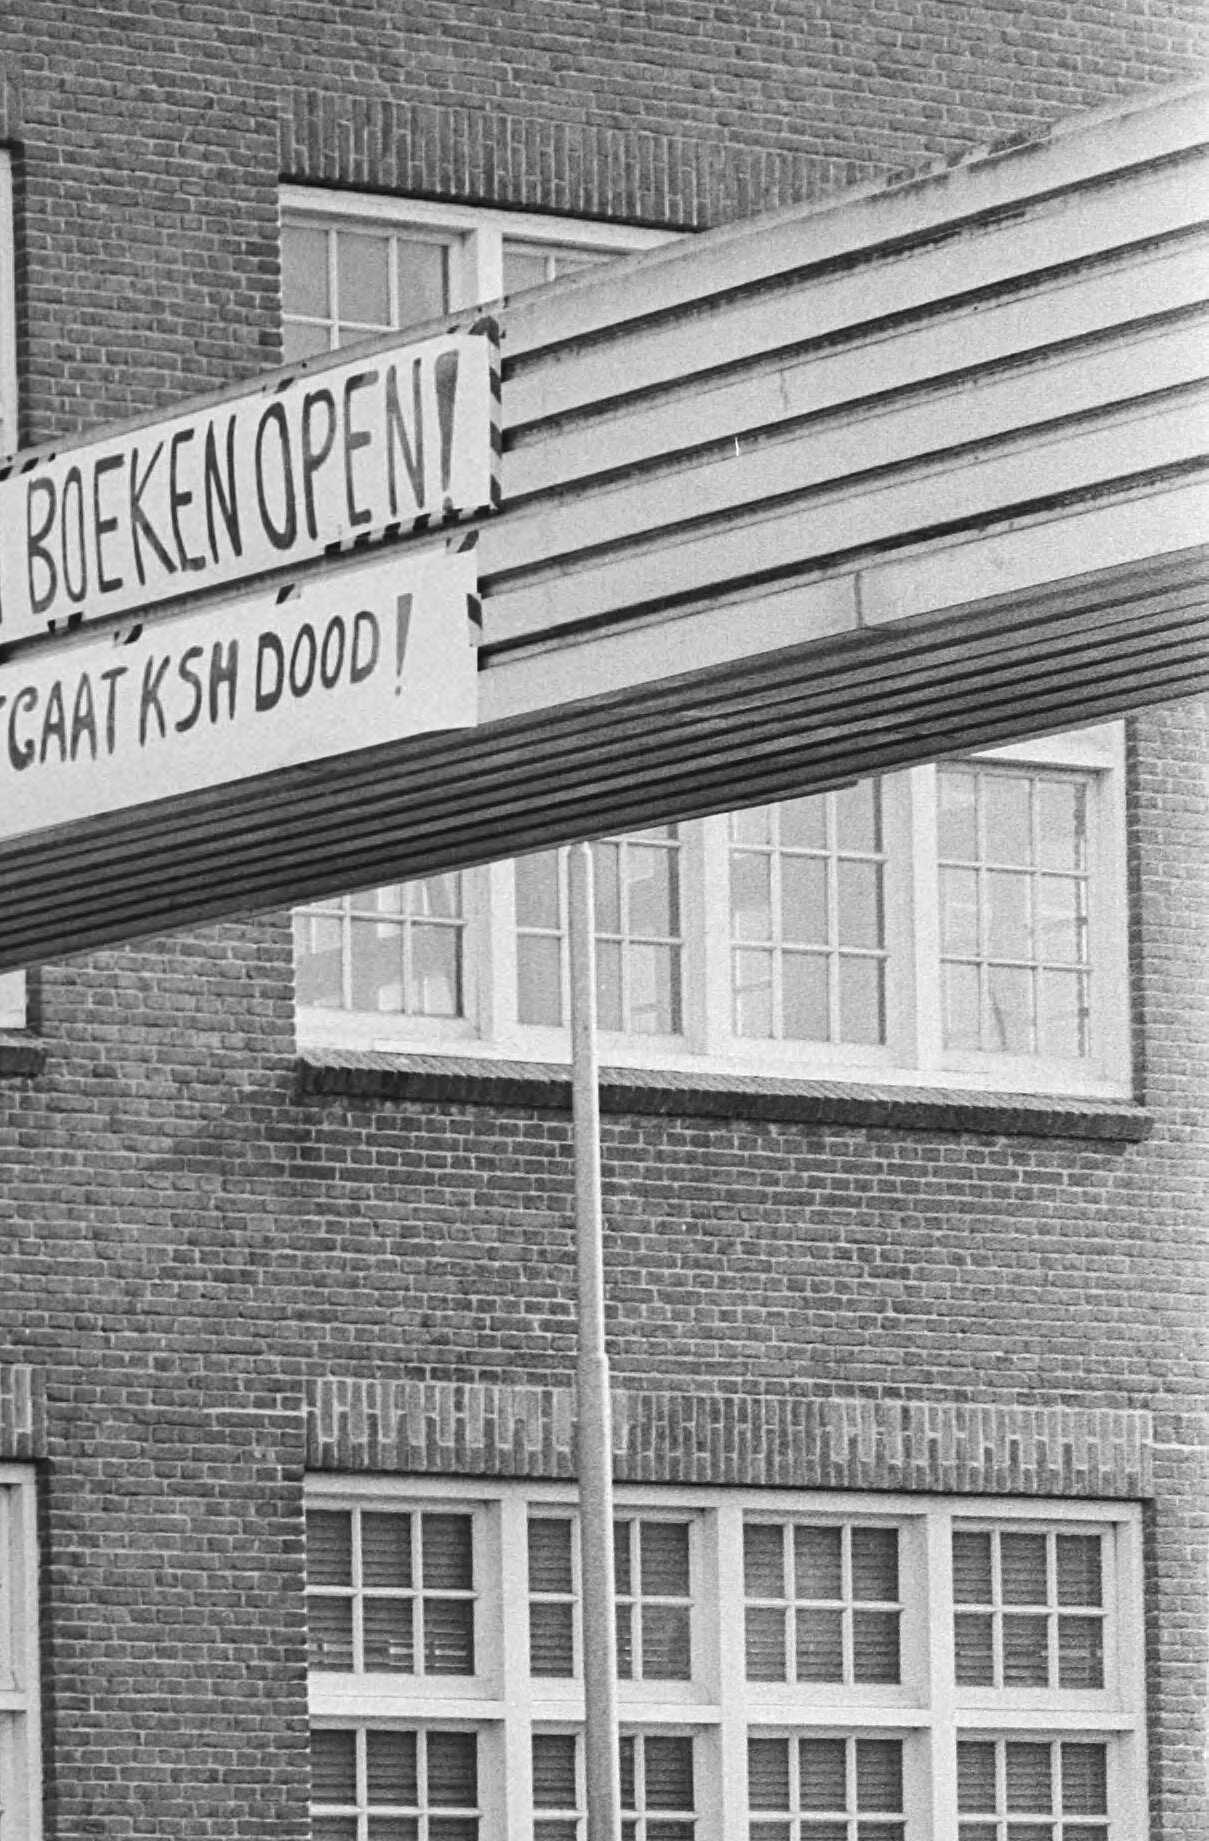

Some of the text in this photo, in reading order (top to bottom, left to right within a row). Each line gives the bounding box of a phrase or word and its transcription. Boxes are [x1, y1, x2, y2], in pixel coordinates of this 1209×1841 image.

[27, 413, 243, 614] BOEKEN
[255, 349, 460, 551] OPEN!
[139, 638, 239, 747] KSH
